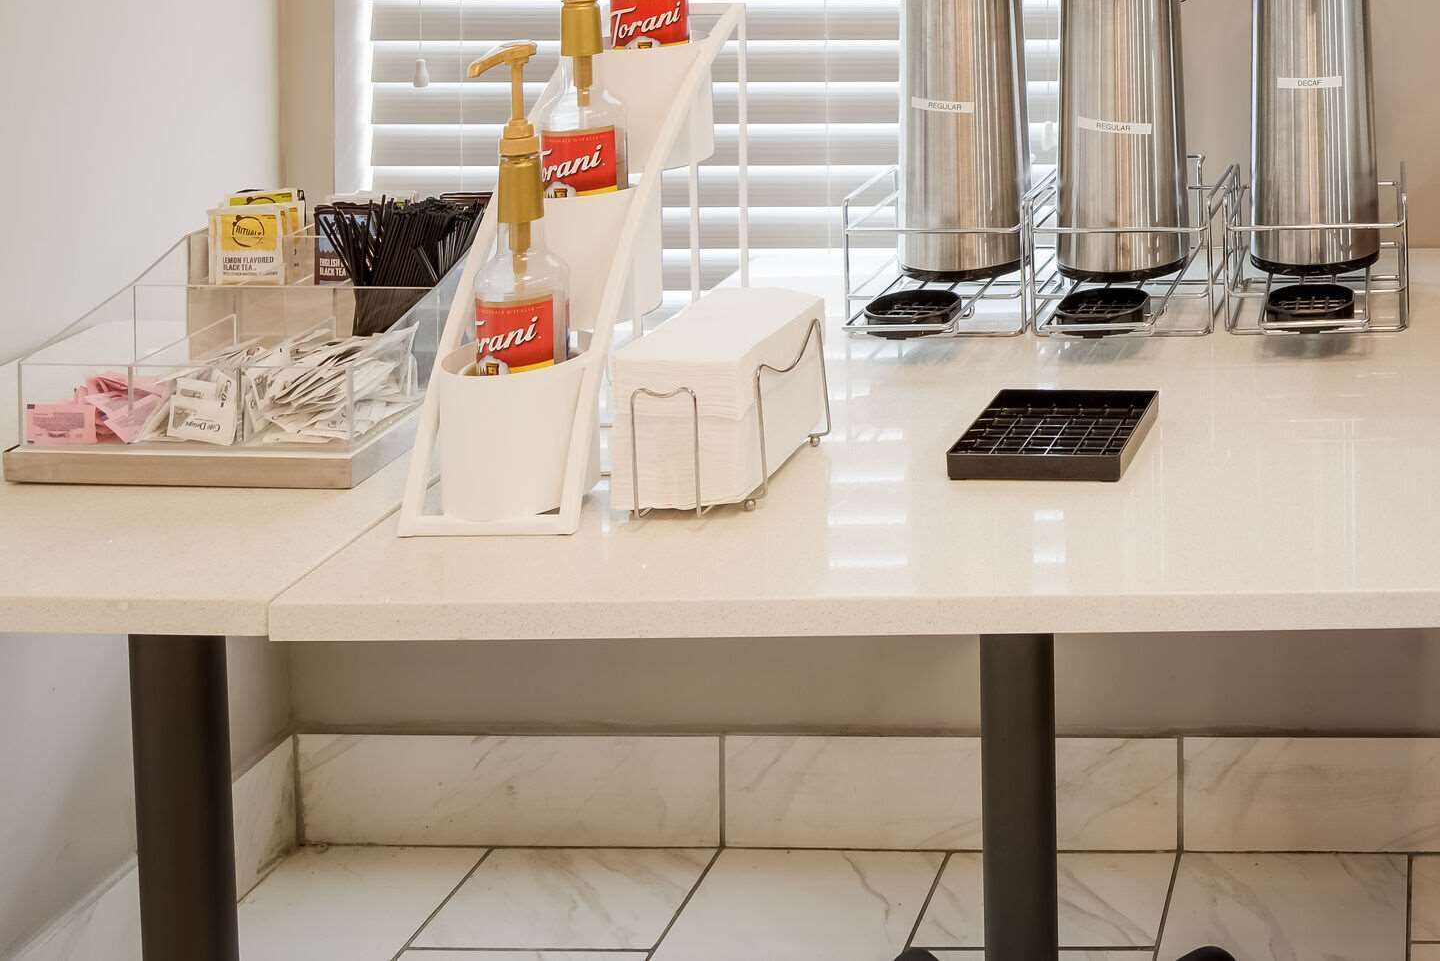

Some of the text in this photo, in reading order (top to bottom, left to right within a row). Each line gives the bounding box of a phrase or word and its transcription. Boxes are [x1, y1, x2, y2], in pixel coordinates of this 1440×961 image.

[610, 1, 681, 47] Torani
[1297, 79, 1324, 87] DECAF
[928, 101, 962, 111] REGULAR
[1096, 122, 1131, 132] REGULAR
[223, 256, 274, 264] LEMON FLAVORED
